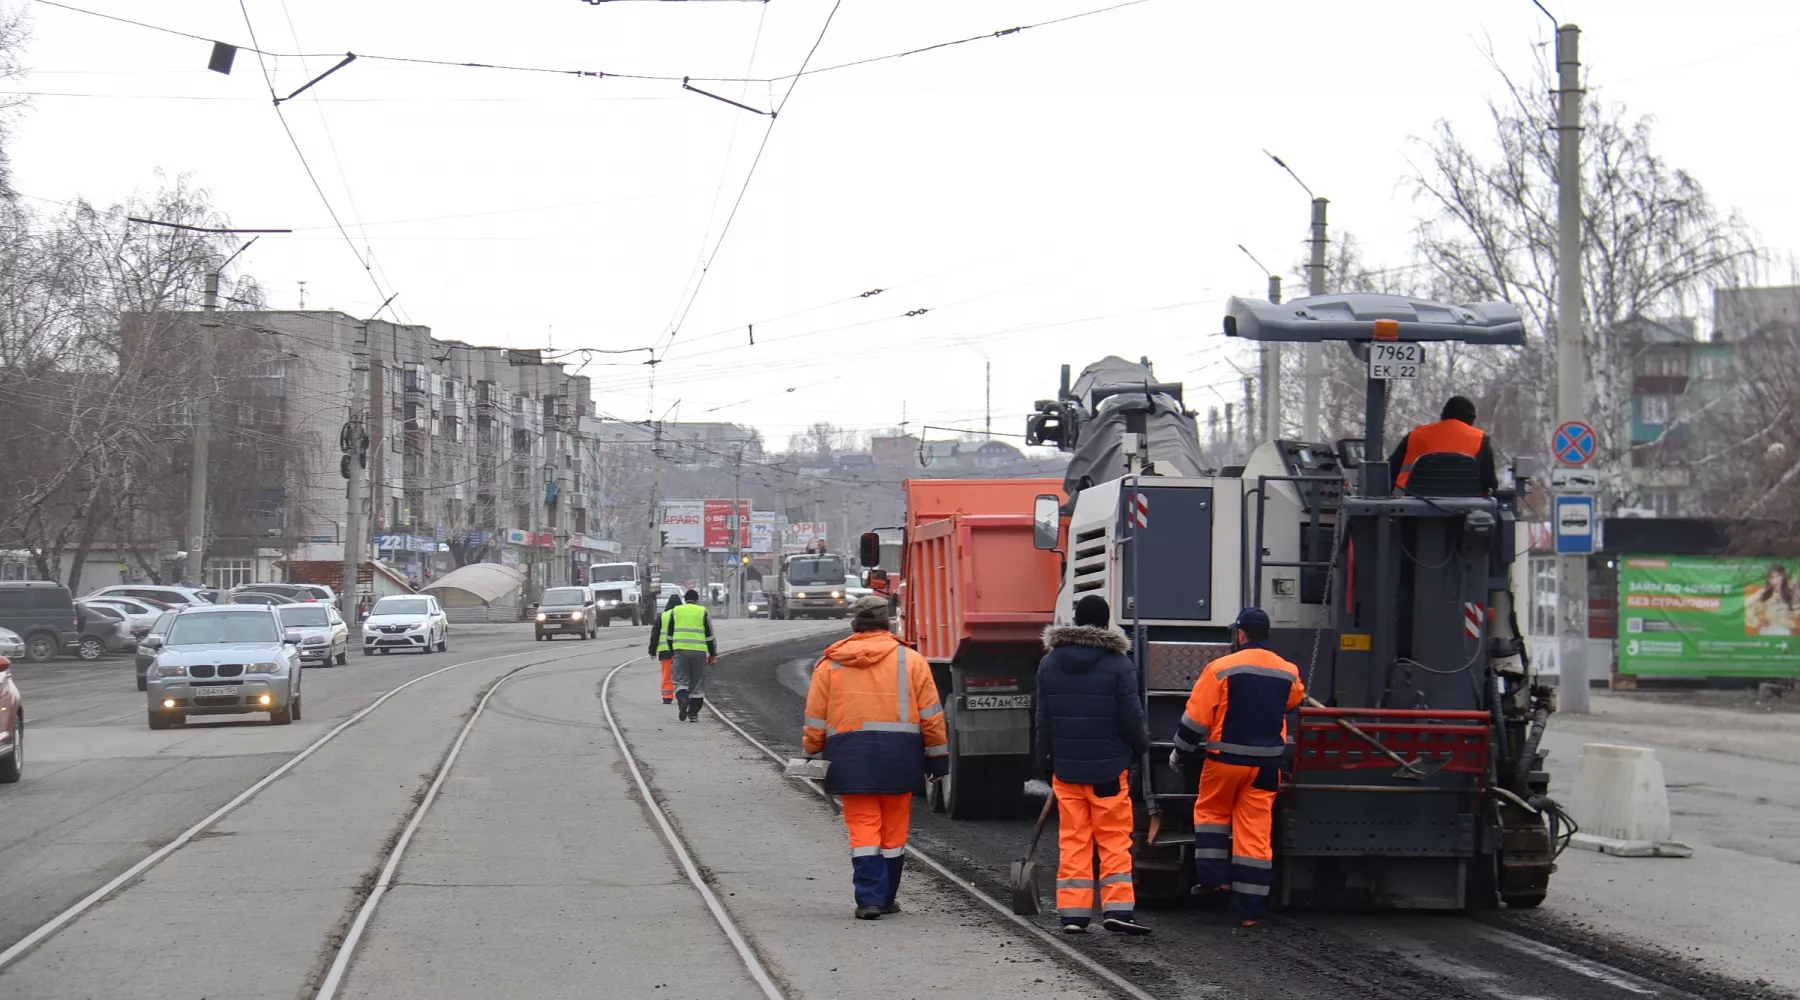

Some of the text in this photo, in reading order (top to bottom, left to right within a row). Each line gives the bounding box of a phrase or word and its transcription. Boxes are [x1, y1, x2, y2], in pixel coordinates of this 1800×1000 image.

[1376, 345, 1415, 361] 7962
[1400, 366, 1416, 378] 22
[1628, 596, 1650, 606] БЕЗ
[970, 697, 1011, 708] В447АН
